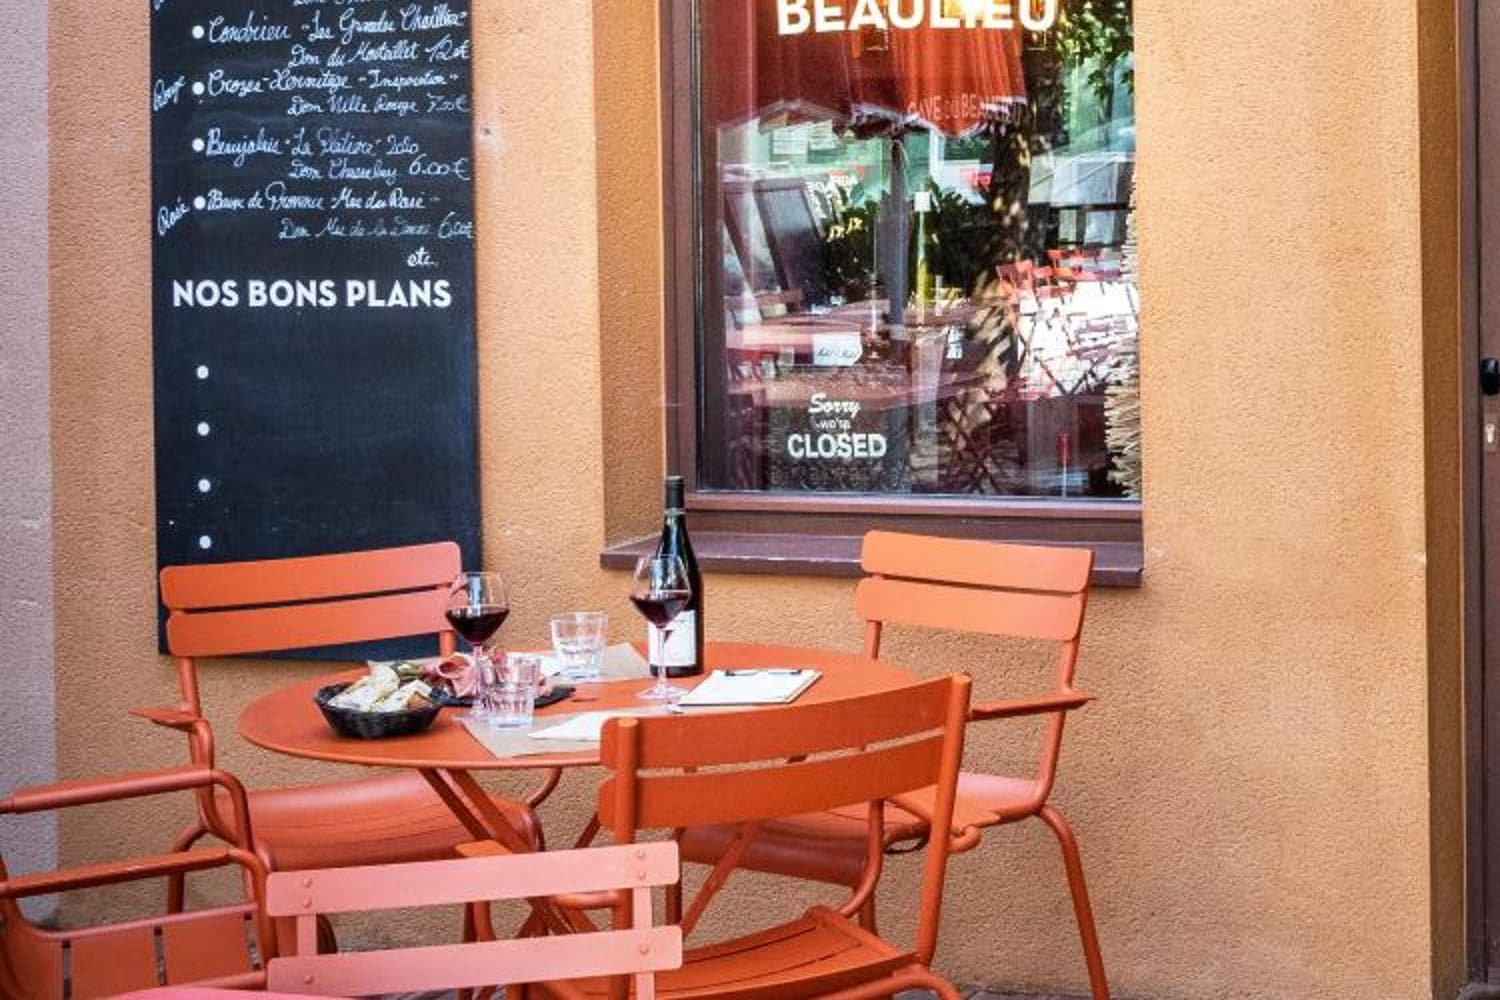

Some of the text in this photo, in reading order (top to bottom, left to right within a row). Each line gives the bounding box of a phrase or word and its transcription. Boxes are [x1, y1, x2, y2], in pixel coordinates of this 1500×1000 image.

[173, 280, 451, 308] NOS BONS PLANS
[808, 392, 860, 418] Sorry
[787, 433, 887, 458] CLOSED
